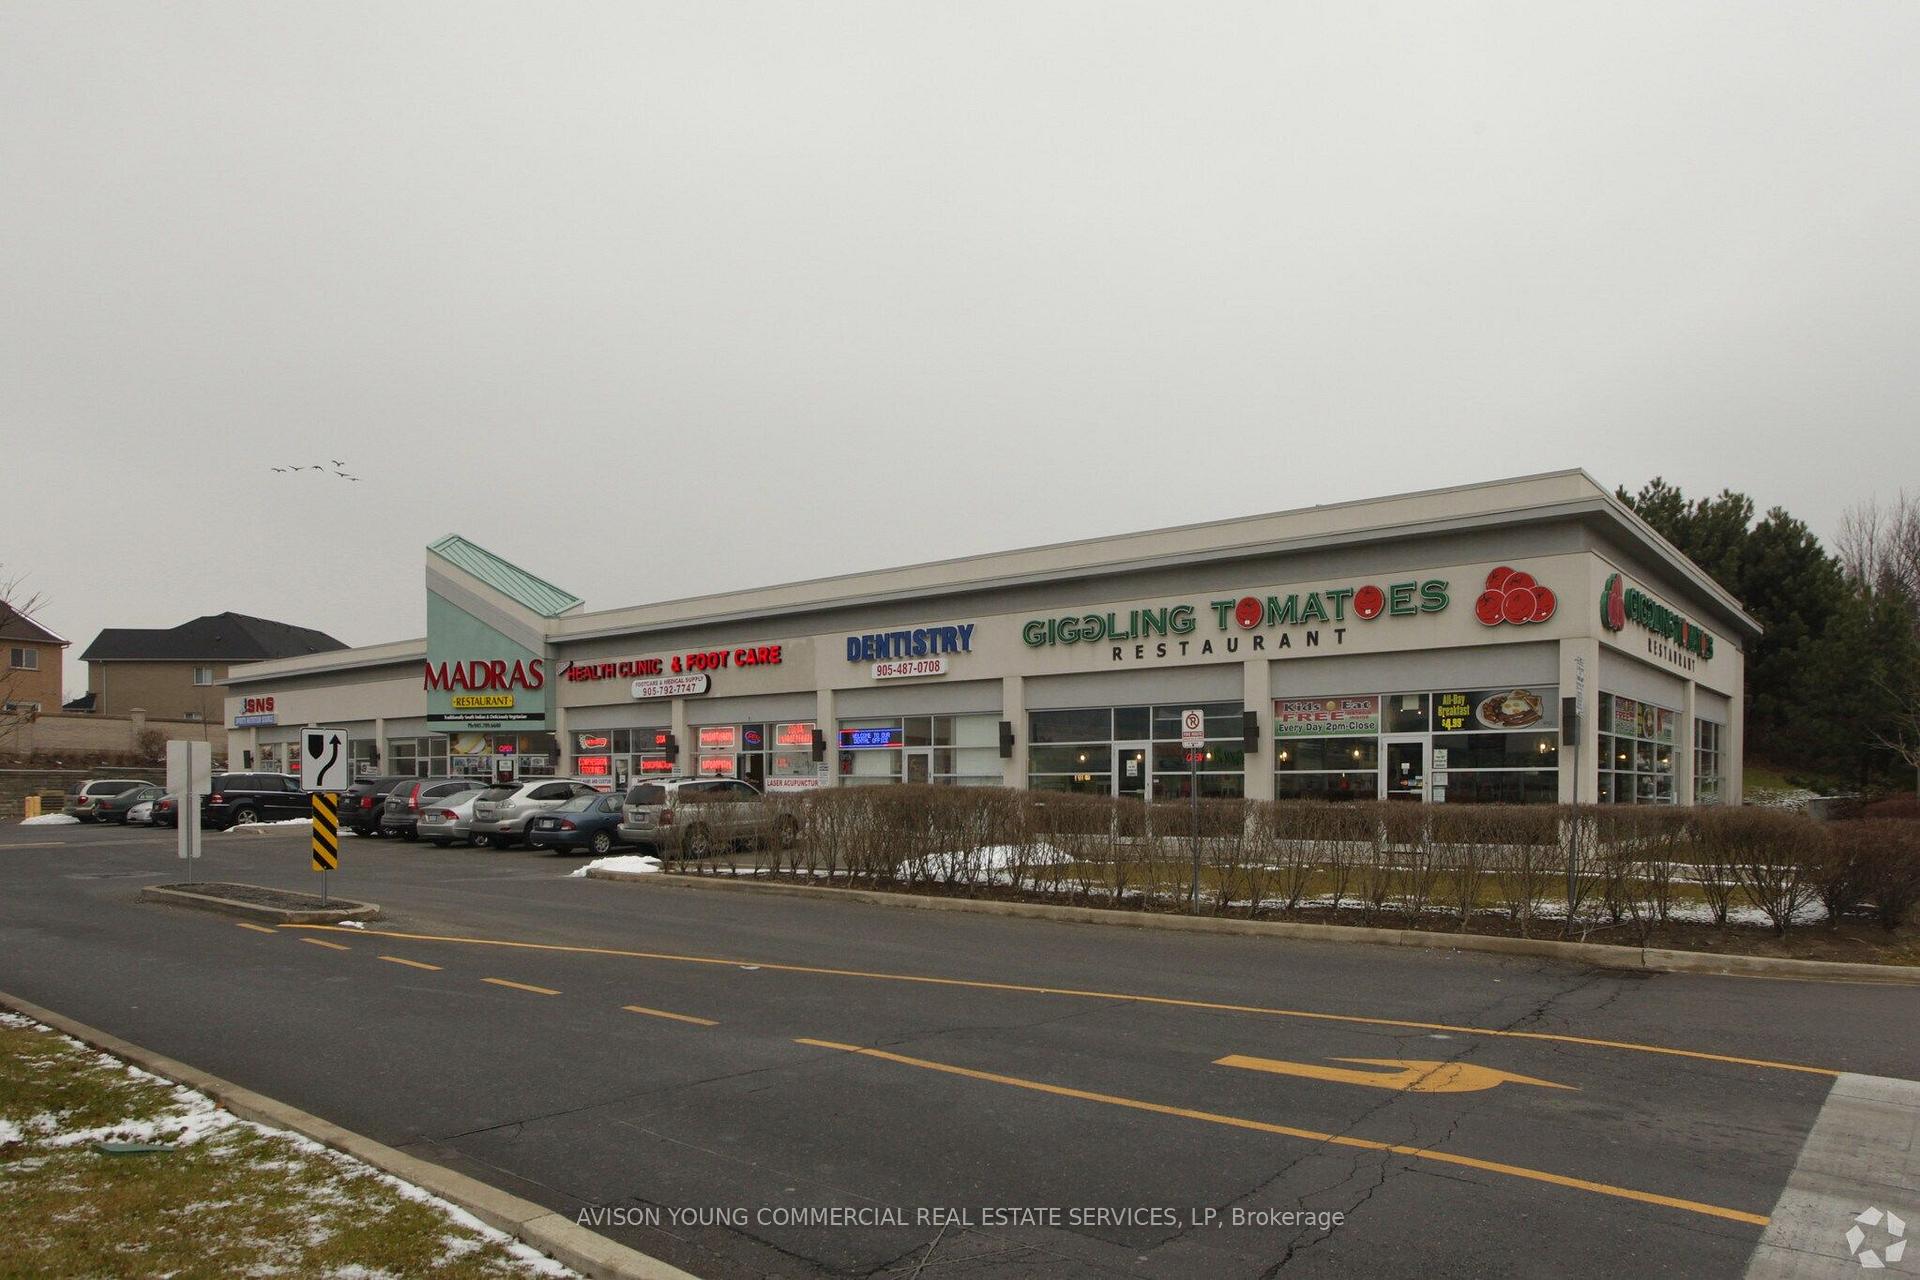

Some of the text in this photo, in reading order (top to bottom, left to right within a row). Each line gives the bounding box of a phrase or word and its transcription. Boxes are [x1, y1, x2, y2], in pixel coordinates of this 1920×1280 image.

[847, 624, 975, 662] DENTISTRY
[1112, 628, 1347, 661] RESTAURANT
[1648, 638, 1695, 673] RESTAURANT
[567, 645, 782, 681] HEALTH CLINIC & FOOT CARE
[876, 660, 940, 676] 905-487-0708
[424, 659, 544, 691] MADRAS
[642, 683, 696, 696] 905-792-7747
[456, 696, 509, 706] RESTAURANT
[1284, 701, 1321, 712] Kids
[1282, 711, 1345, 722] FREE
[1437, 705, 1470, 716] Breakfast
[1279, 721, 1375, 733] Every Day 2pm-Close
[784, 778, 818, 787] ACUPUNCTUR
